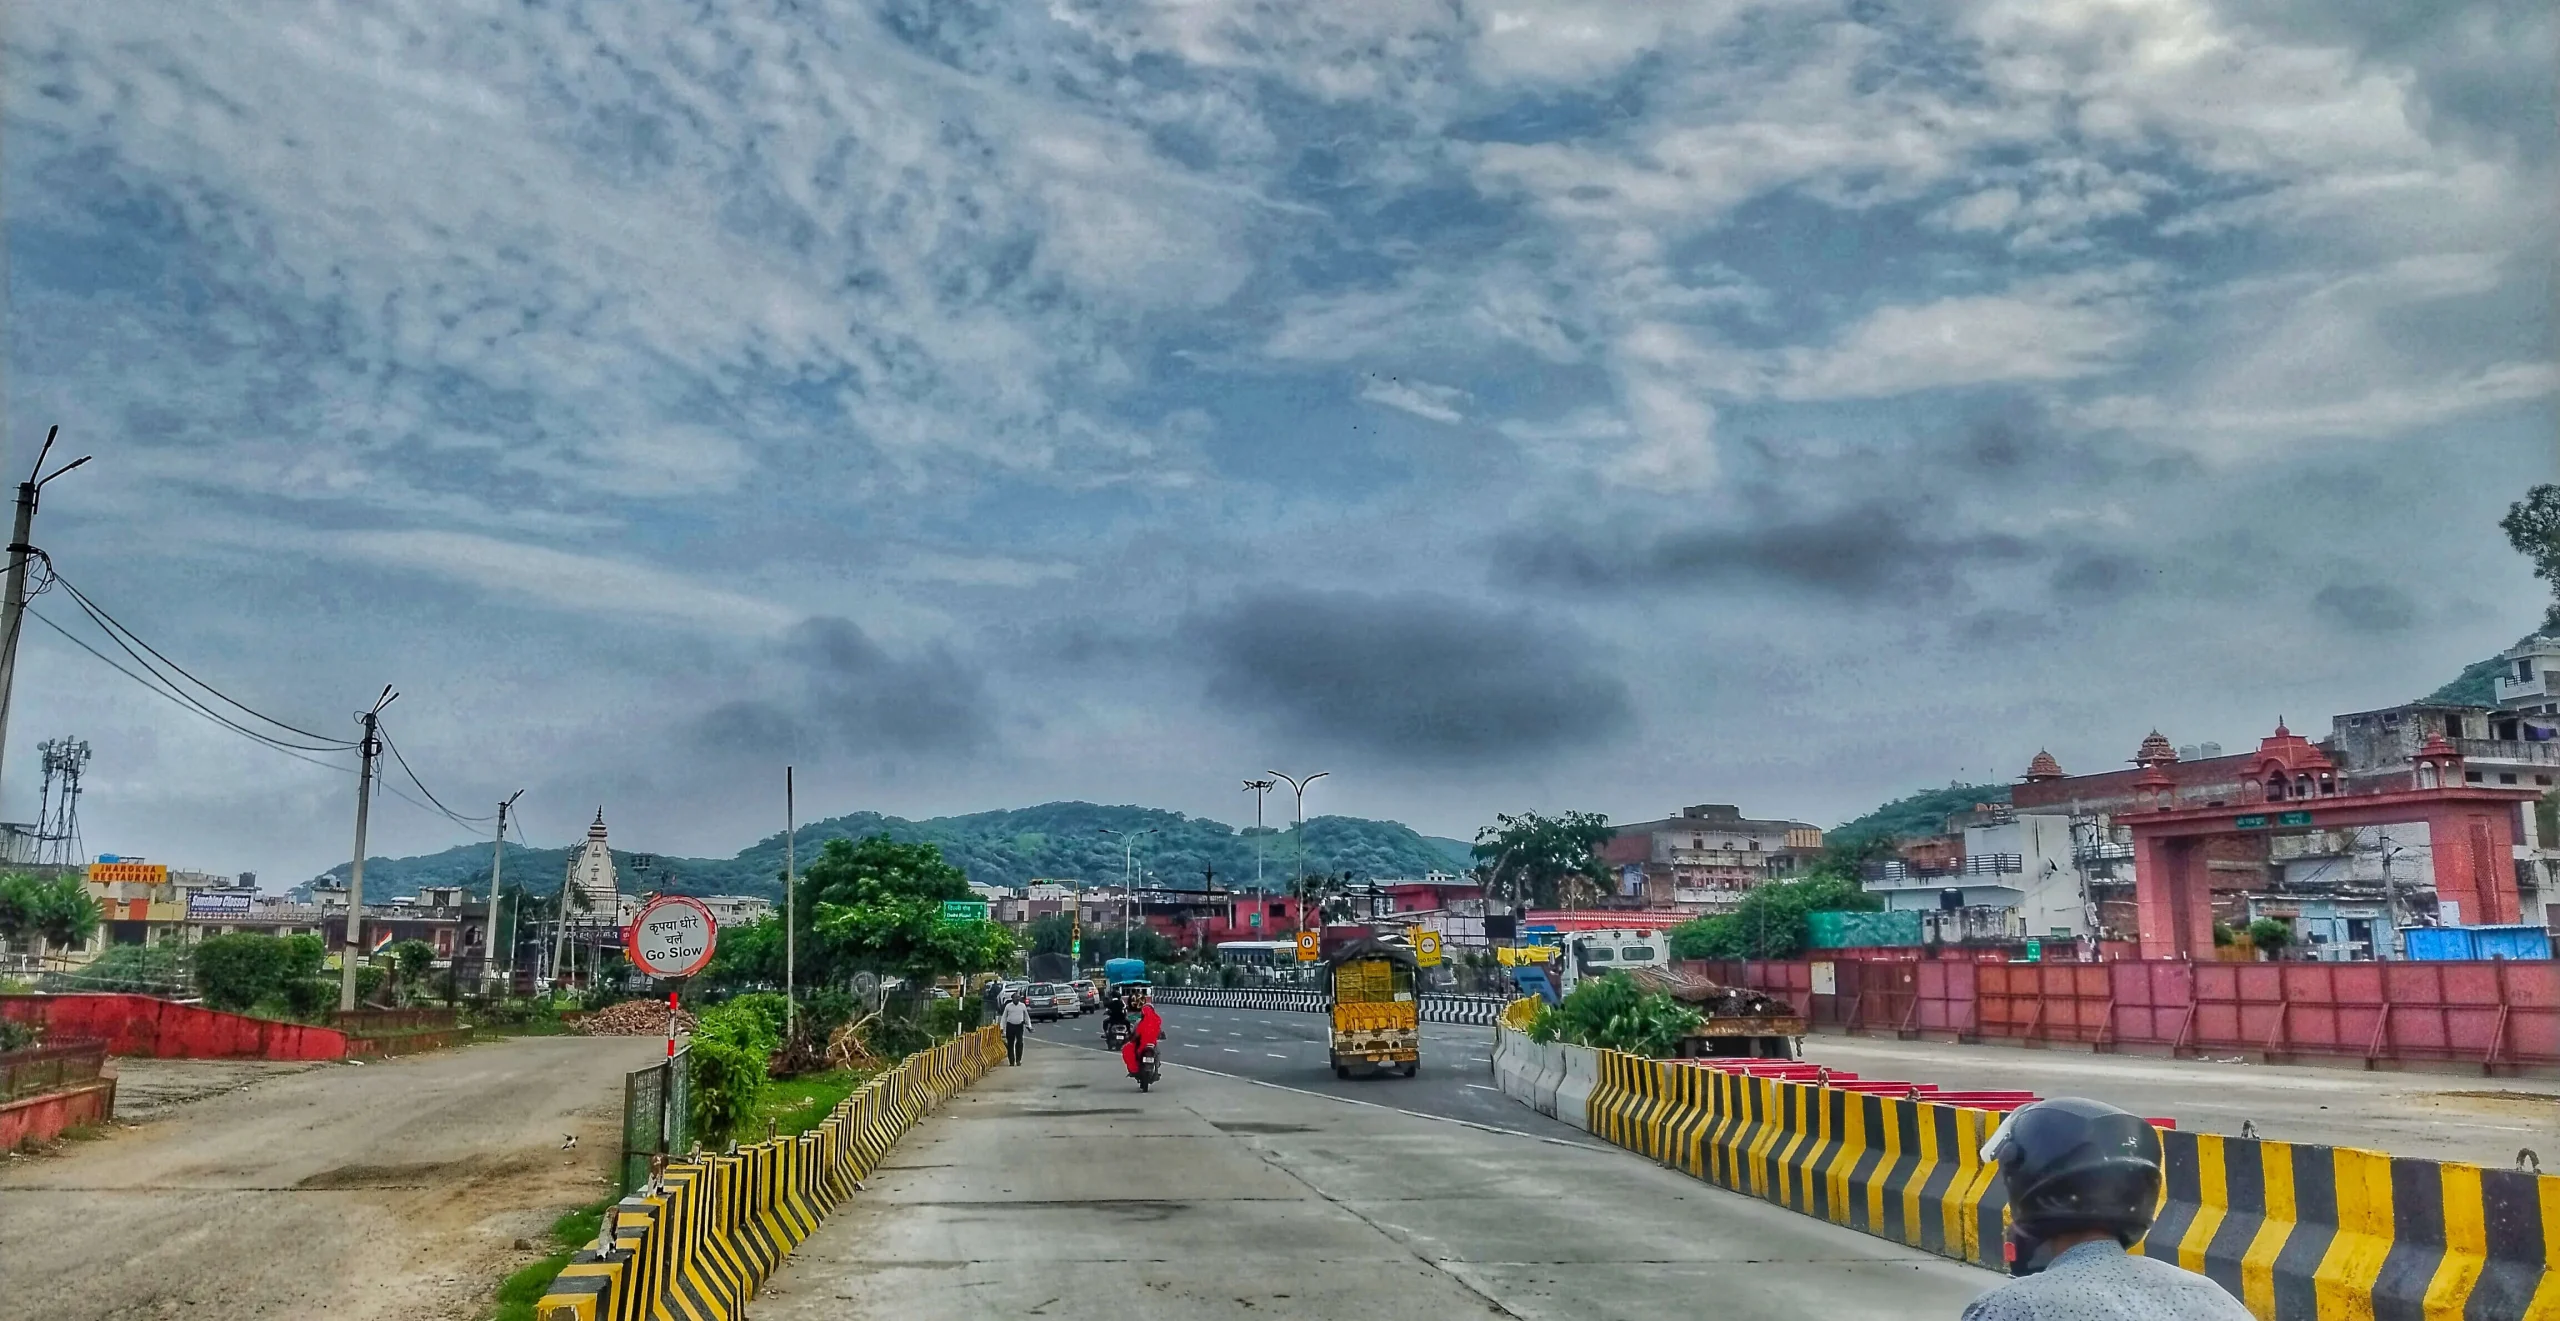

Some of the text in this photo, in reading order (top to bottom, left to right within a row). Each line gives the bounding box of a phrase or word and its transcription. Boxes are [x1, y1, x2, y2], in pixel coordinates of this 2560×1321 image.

[93, 872, 162, 882] RESTAURANT
[648, 920, 678, 936] कृपया
[679, 915, 699, 929] धीरे
[664, 931, 684, 945] चलें
[645, 946, 703, 961] Go Slow
